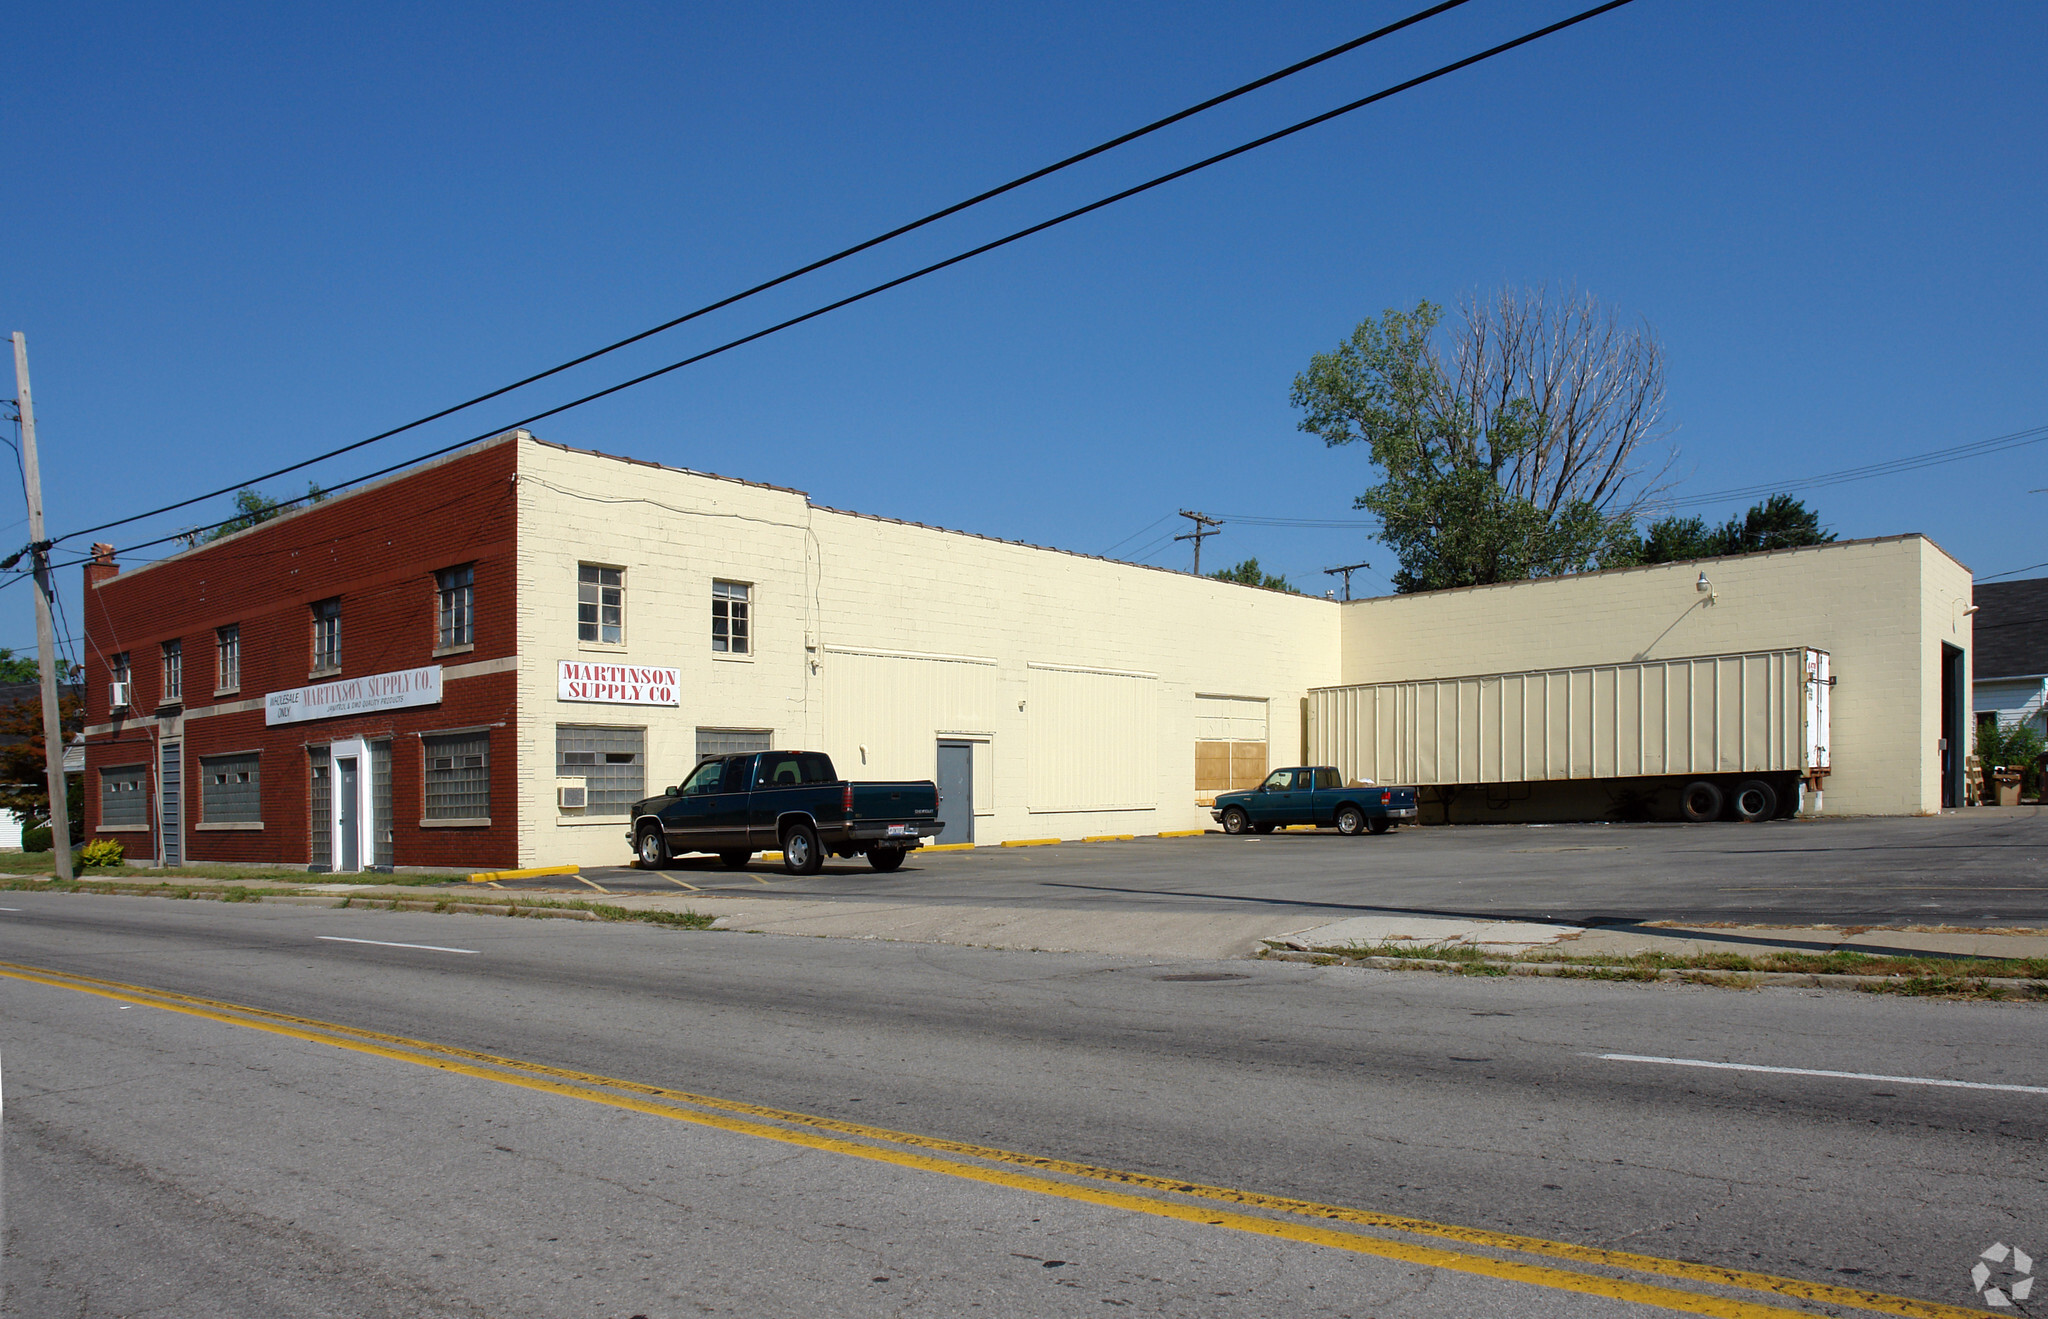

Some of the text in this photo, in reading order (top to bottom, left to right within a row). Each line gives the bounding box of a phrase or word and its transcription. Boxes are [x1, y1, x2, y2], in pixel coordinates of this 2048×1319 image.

[563, 663, 676, 686] MARTINSON
[303, 670, 432, 707] MARTINSON SUPPLY CO.
[568, 681, 676, 702] SUPPLY CO.
[269, 692, 299, 707] WHOLESALE
[362, 698, 380, 708] QUALITY
[381, 695, 404, 705] PRODUCTS
[277, 706, 291, 718] ONLY
